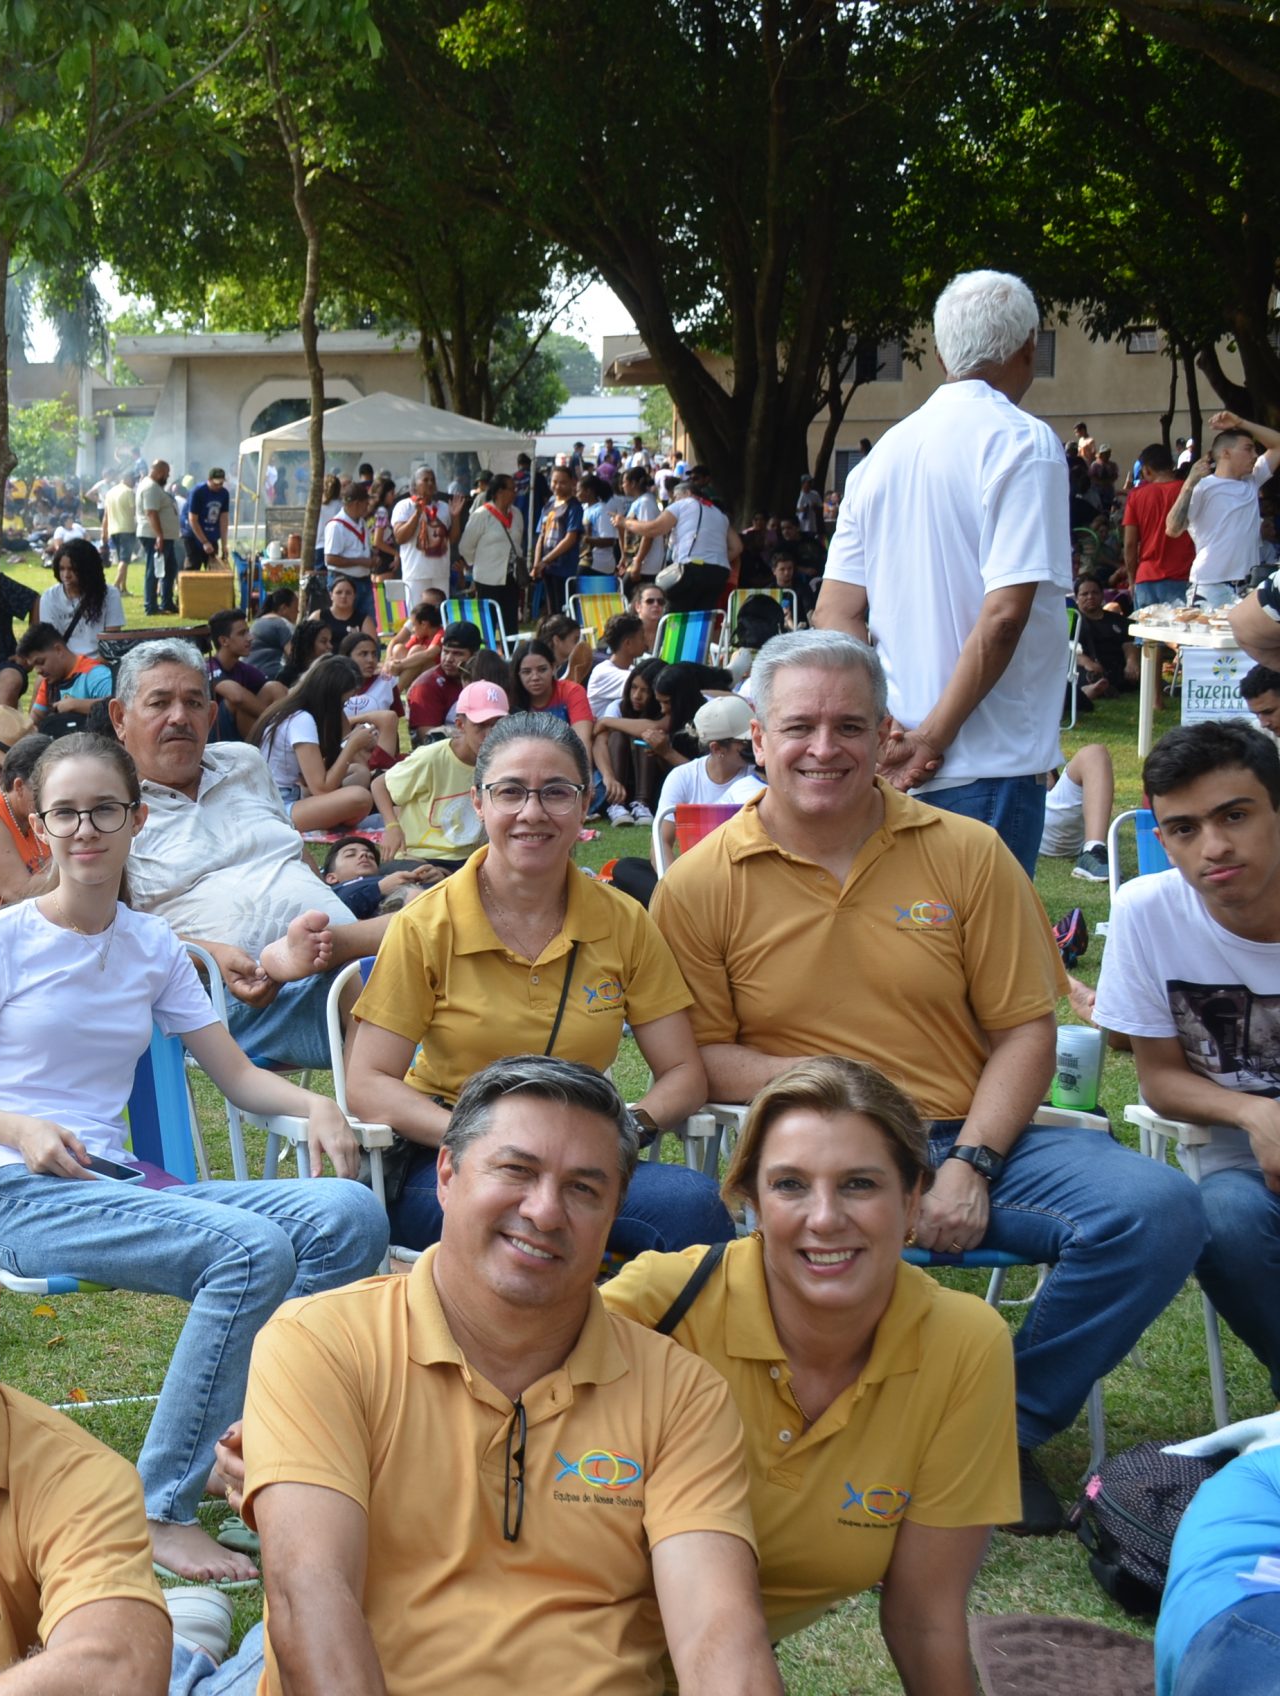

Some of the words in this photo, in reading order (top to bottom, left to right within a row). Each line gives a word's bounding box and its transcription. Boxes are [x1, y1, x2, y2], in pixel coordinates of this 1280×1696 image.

[1186, 700, 1245, 710] ESPERAN
[583, 1492, 591, 1503] de
[593, 1492, 614, 1505] Nossa
